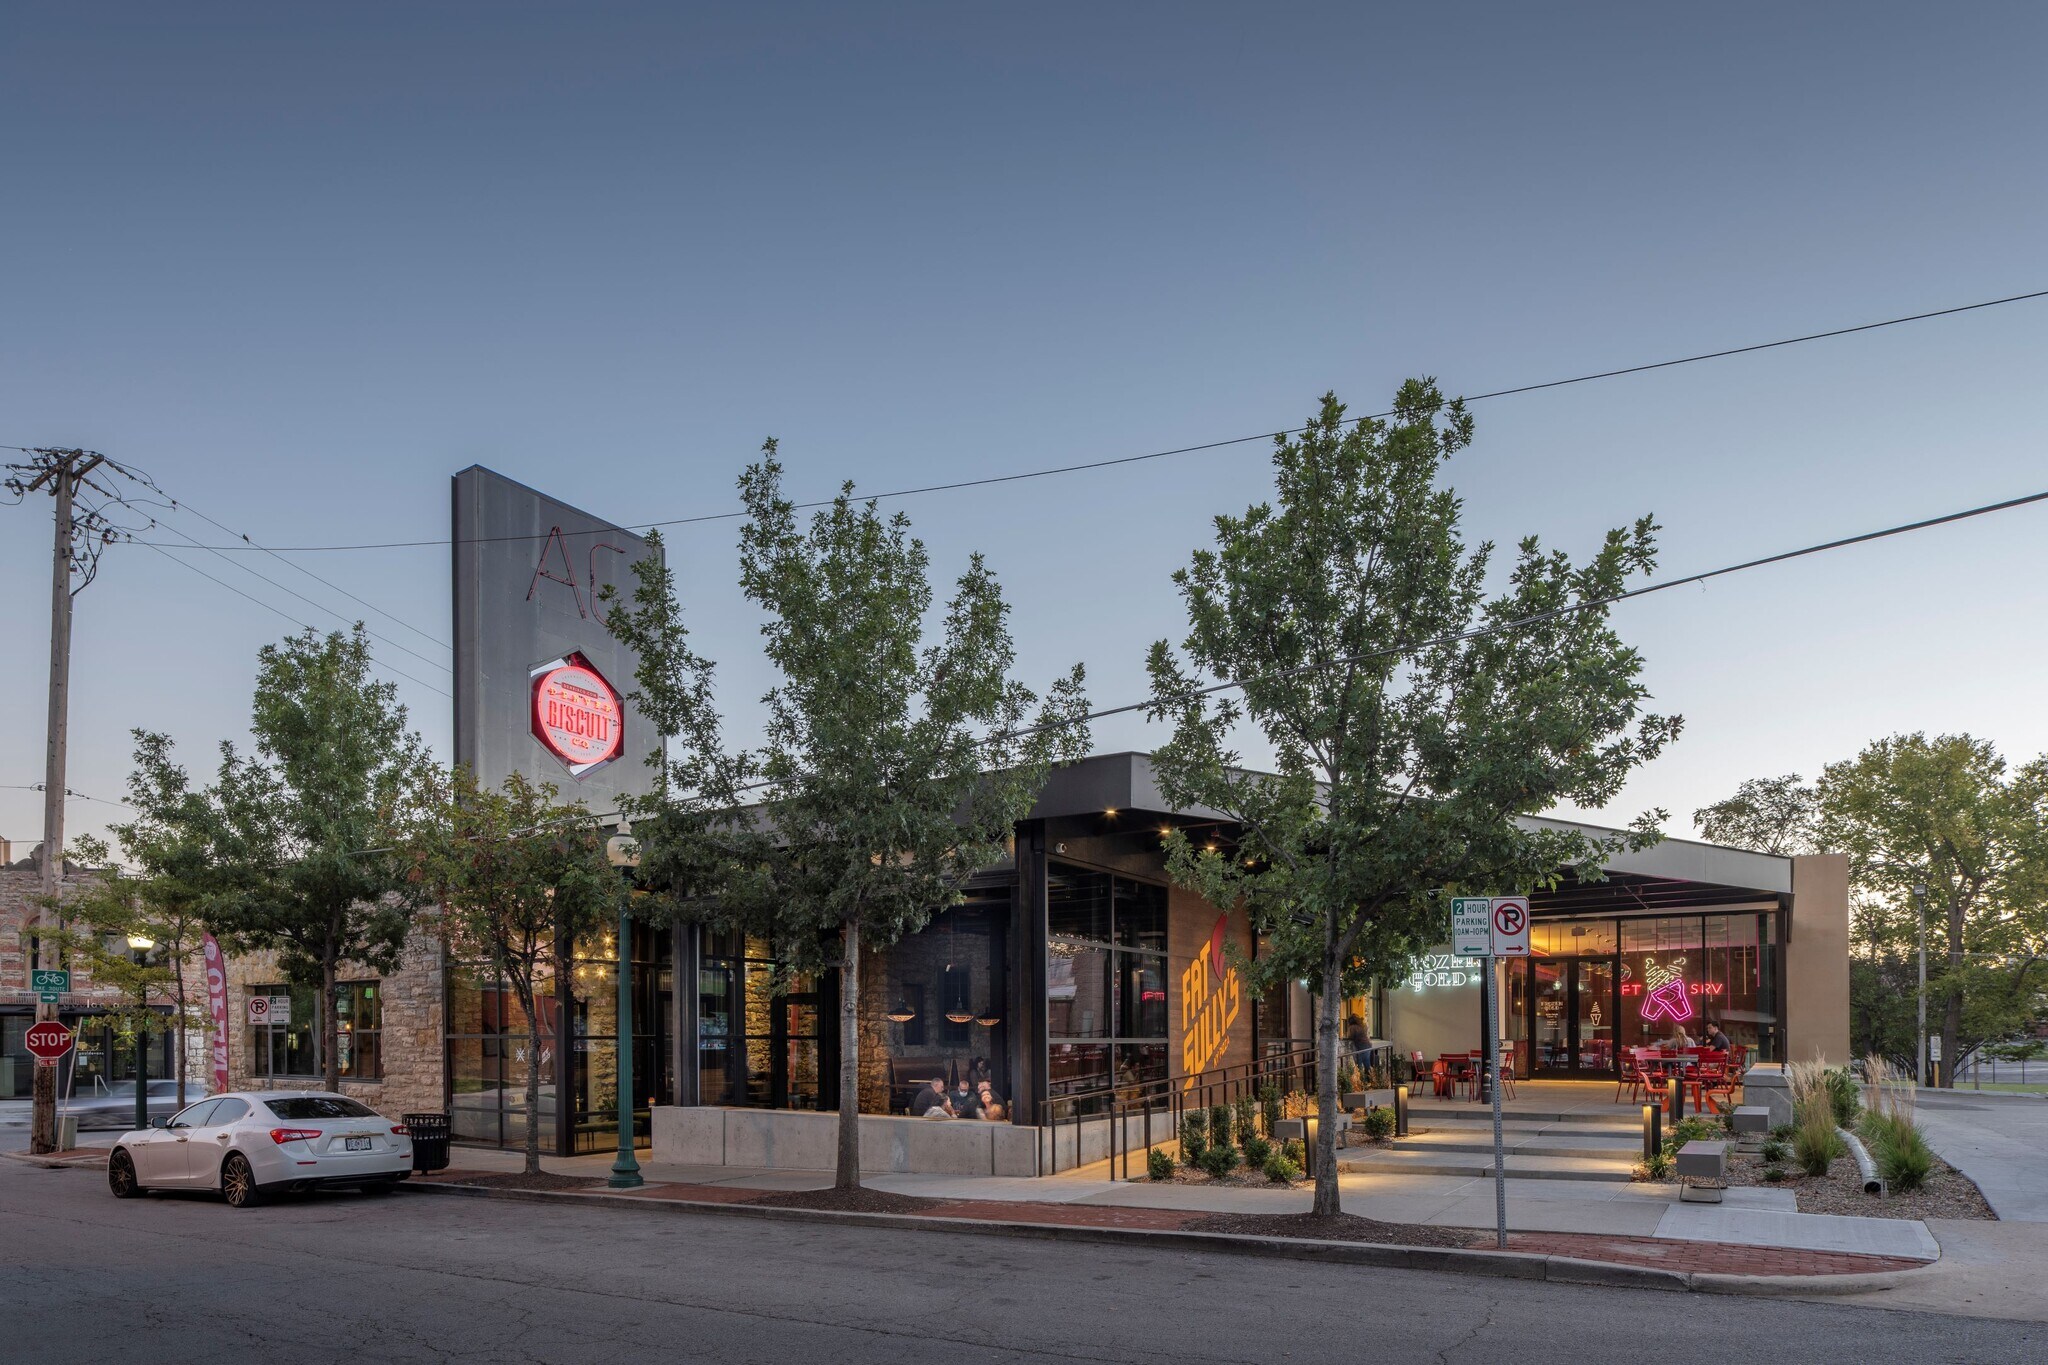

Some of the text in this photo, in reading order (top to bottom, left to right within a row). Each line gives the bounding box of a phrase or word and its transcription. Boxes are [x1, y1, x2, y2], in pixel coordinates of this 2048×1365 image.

[548, 700, 610, 742] BISCUIT
[1456, 902, 1487, 914] 2 HOUR
[1456, 917, 1487, 925] PARKING
[1455, 928, 1488, 936] 10AM-10PM
[1182, 940, 1211, 1032] FAT
[1408, 972, 1466, 992] GOLD
[1691, 983, 1723, 995] SRV
[29, 1033, 70, 1047] STOP
